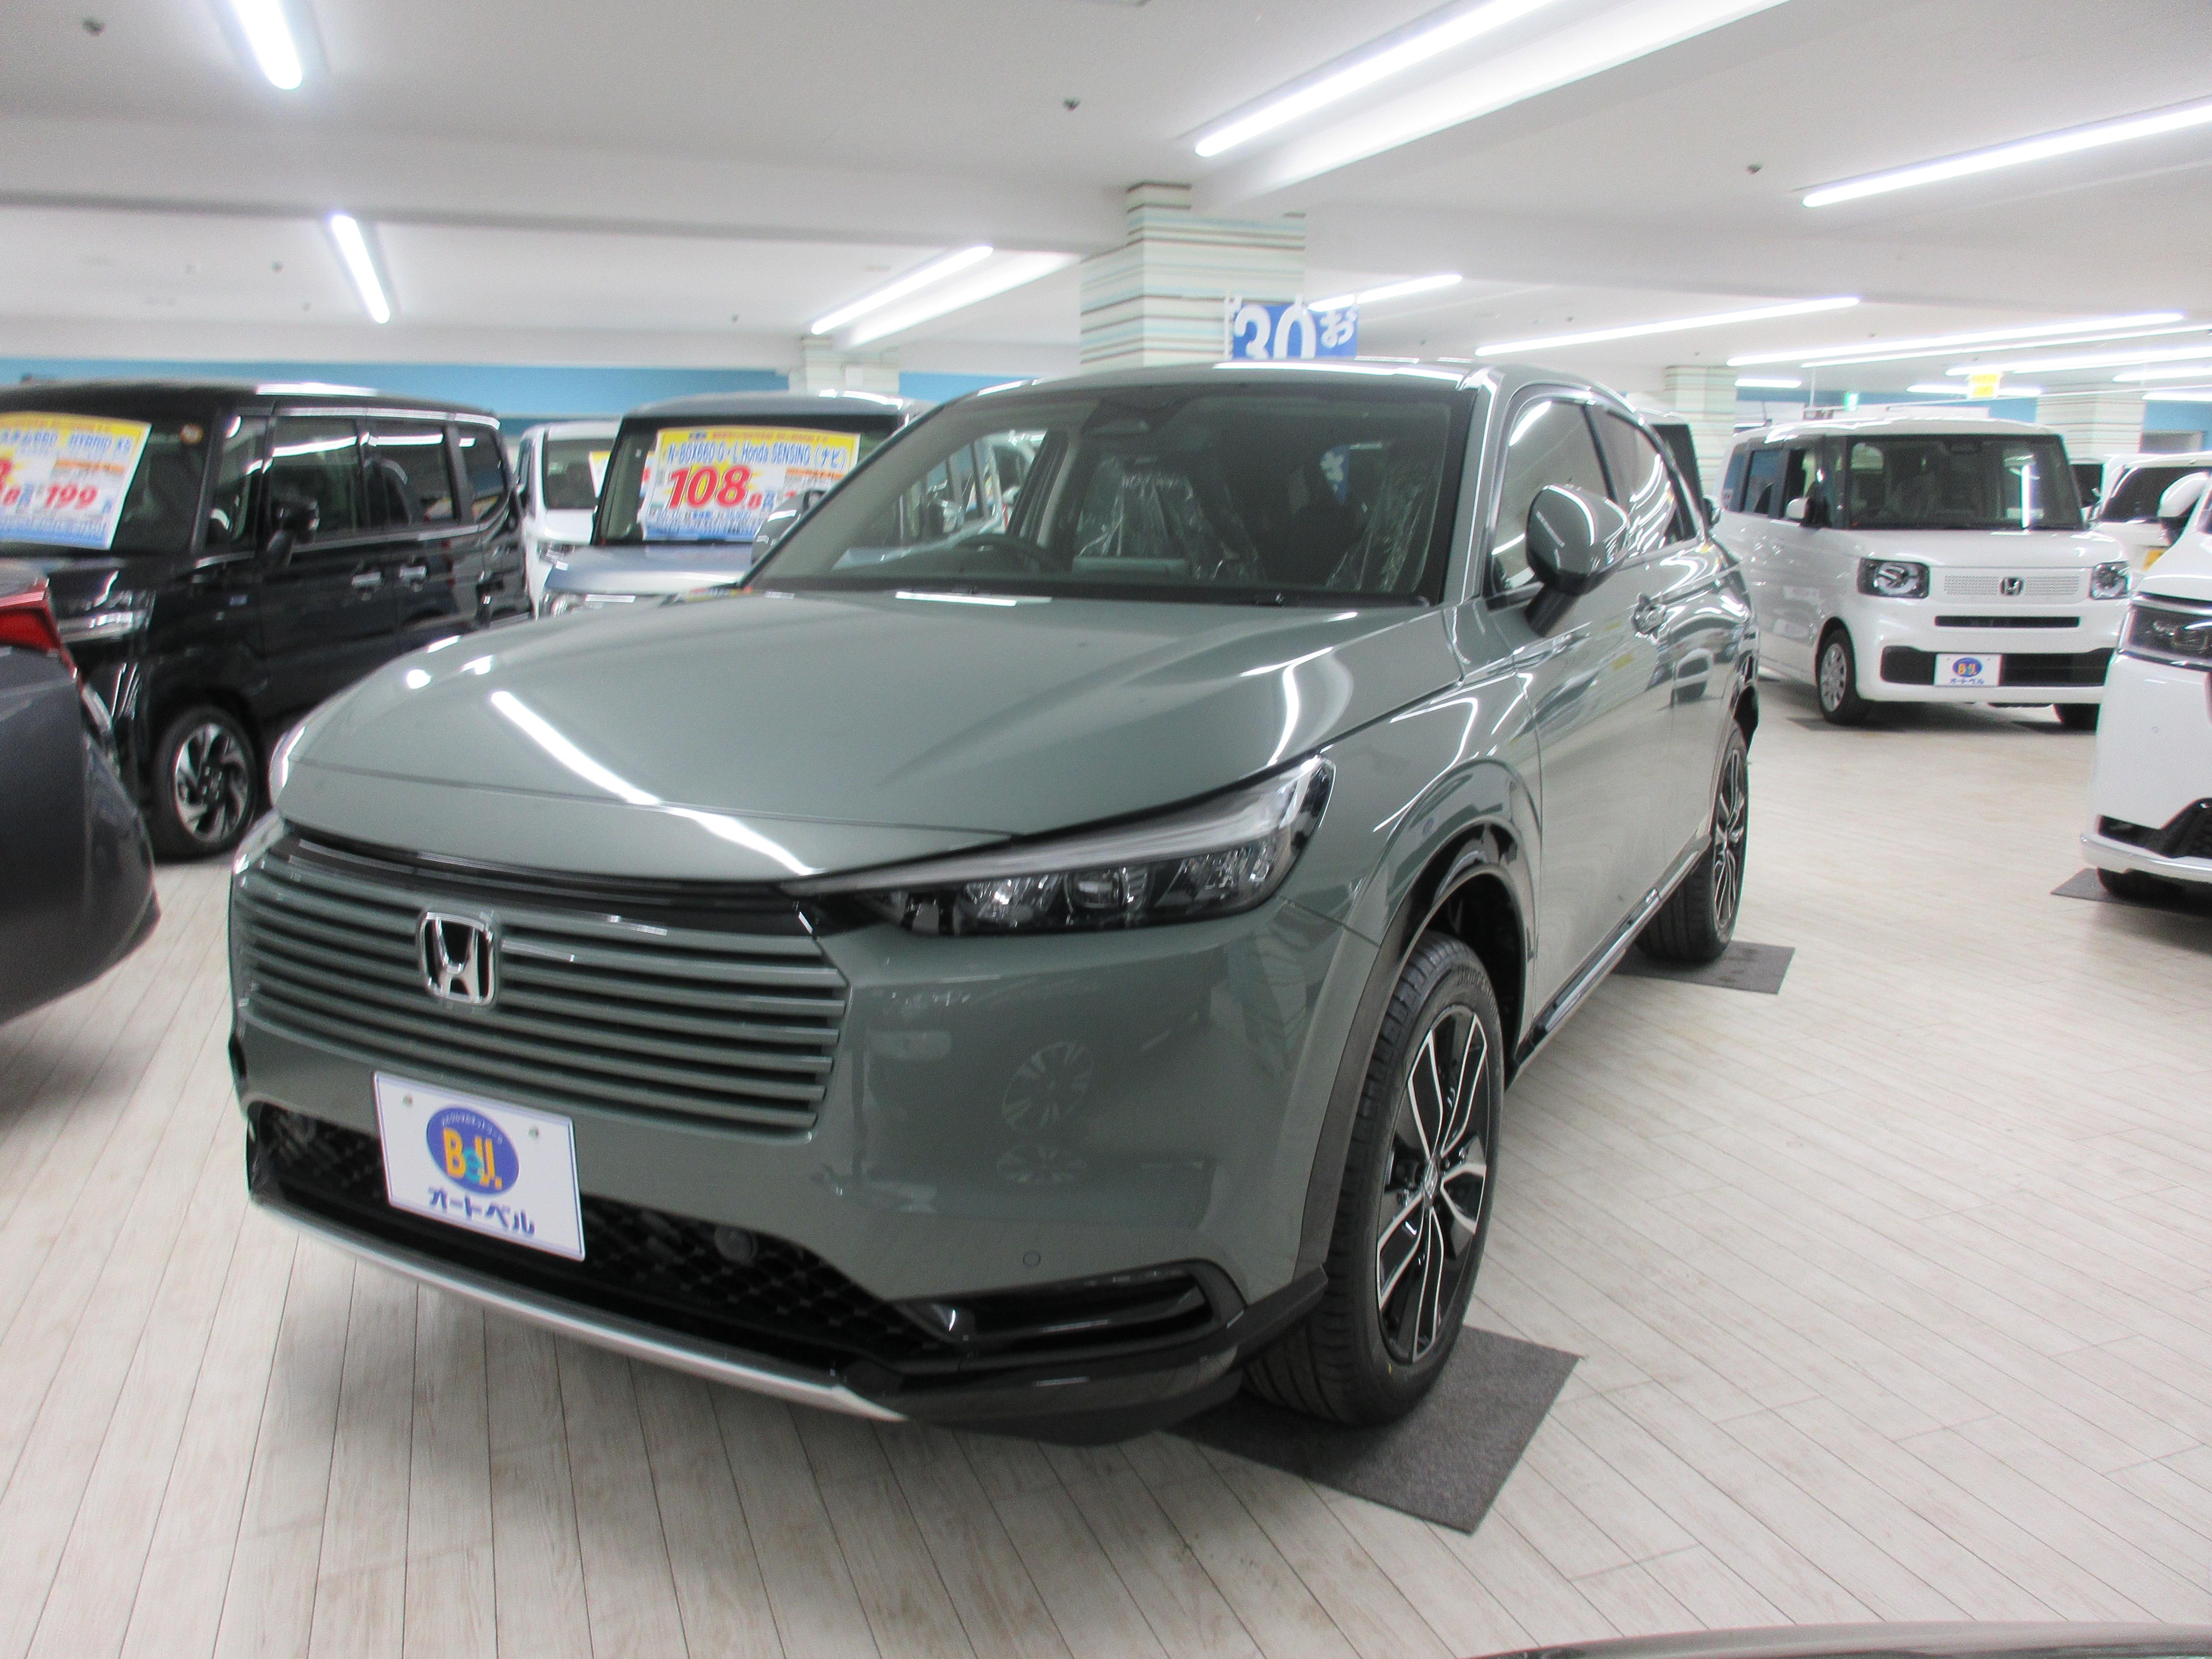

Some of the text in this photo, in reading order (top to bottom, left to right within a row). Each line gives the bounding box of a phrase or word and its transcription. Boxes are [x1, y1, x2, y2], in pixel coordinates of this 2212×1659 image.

[44, 482, 99, 511] 199
[428, 1185, 535, 1235] オートベル
